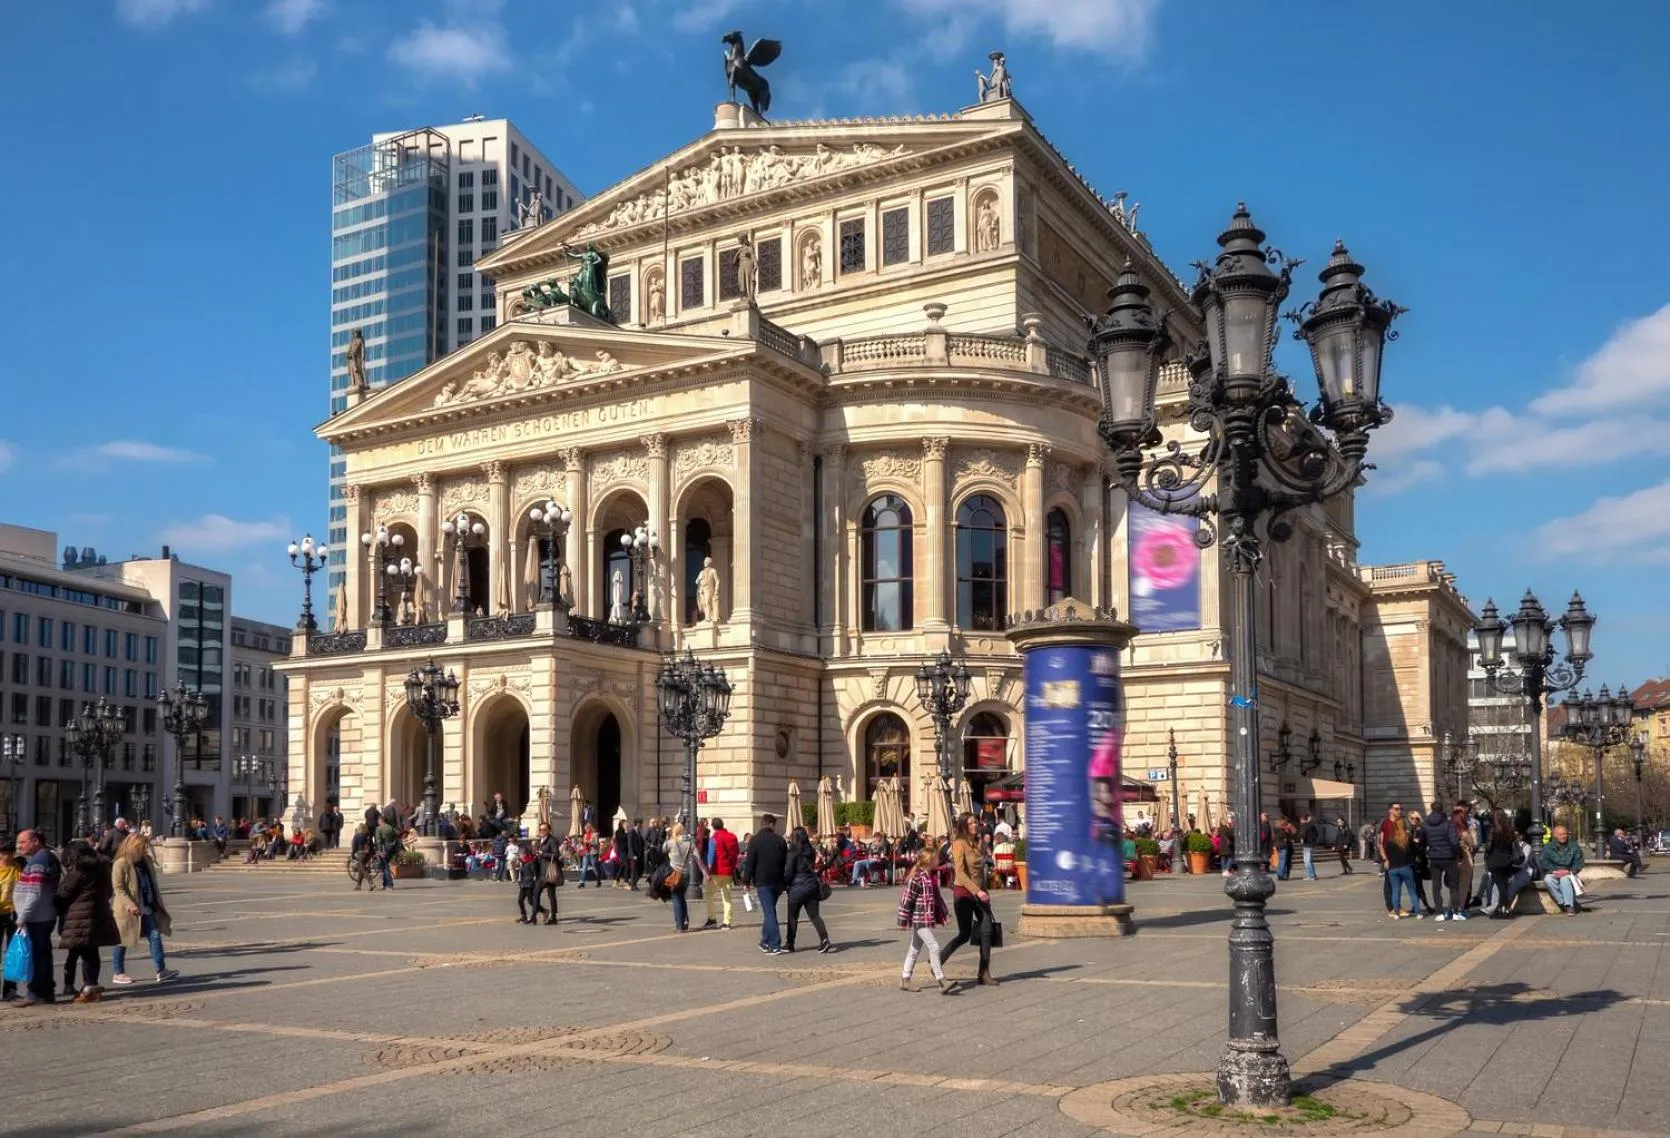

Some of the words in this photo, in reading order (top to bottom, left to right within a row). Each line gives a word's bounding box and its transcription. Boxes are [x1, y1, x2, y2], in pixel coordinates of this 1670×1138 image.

[418, 438, 444, 455] DEM
[450, 426, 506, 448] WAHREN
[514, 410, 590, 437] SCHOENEN
